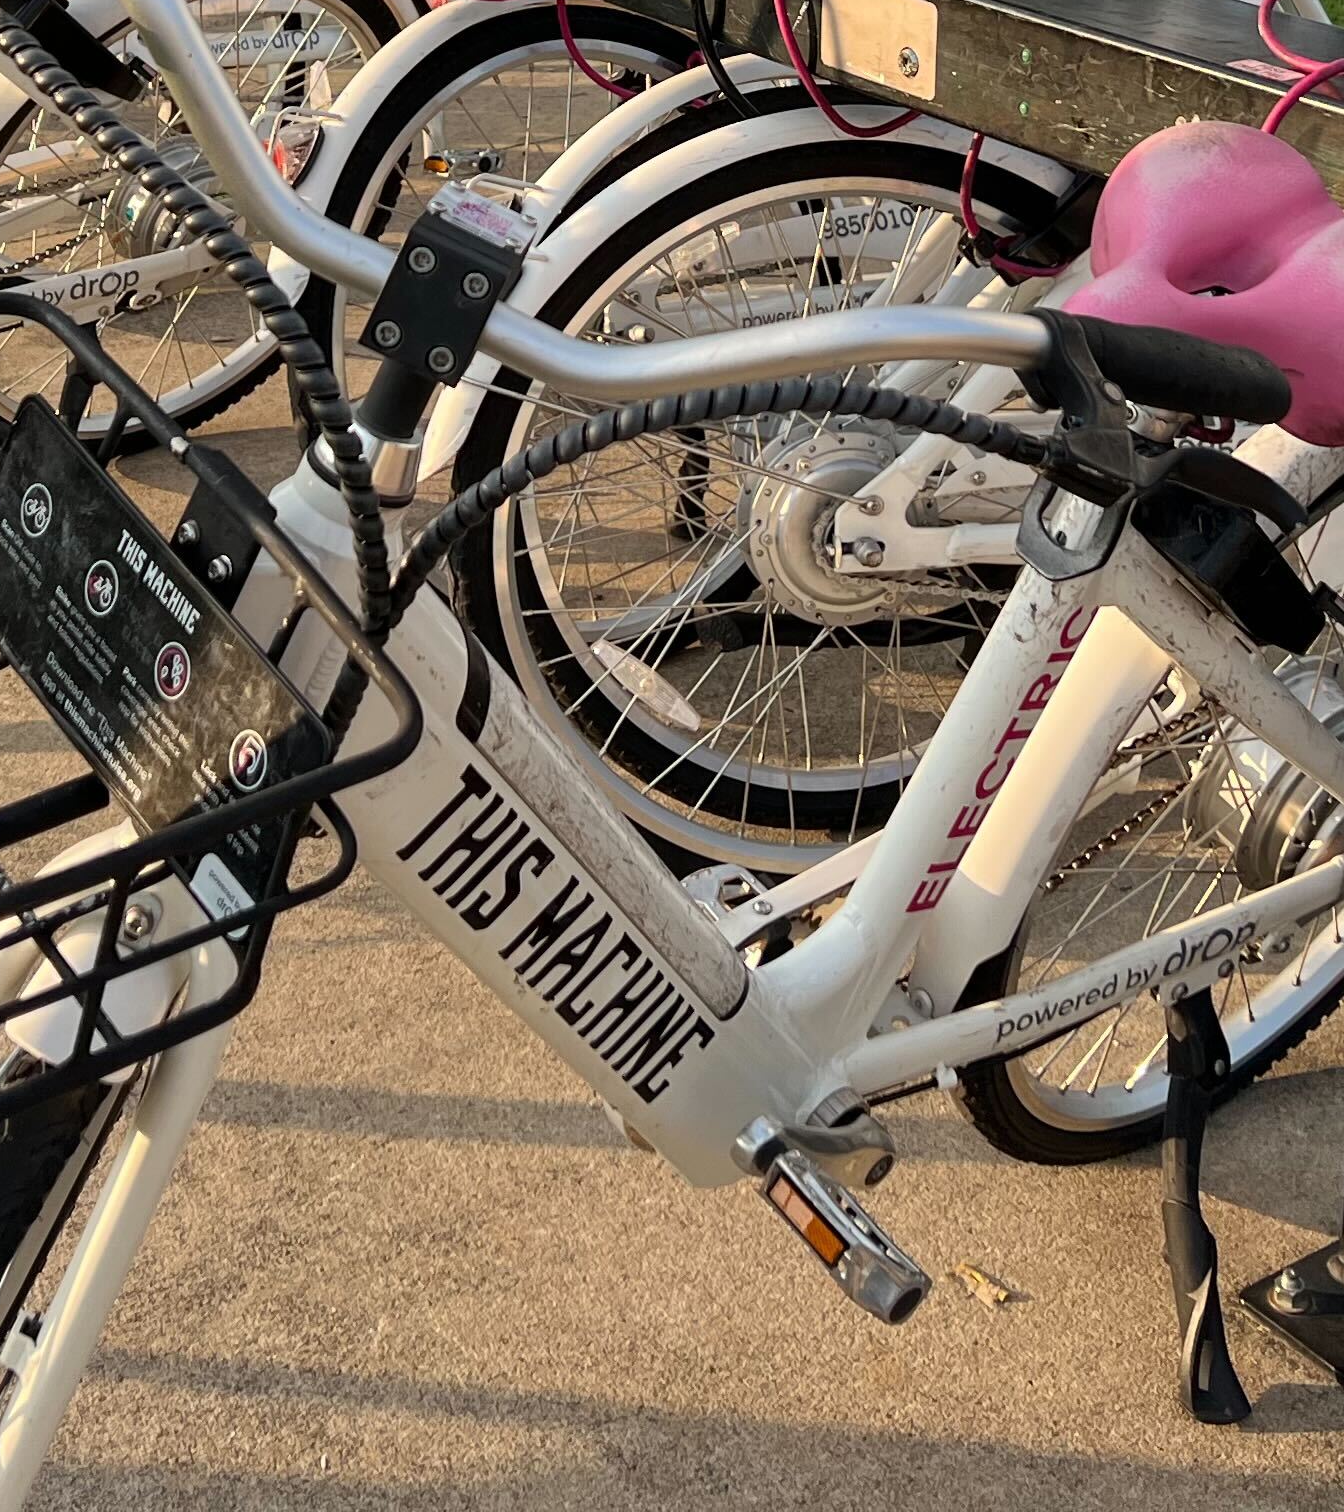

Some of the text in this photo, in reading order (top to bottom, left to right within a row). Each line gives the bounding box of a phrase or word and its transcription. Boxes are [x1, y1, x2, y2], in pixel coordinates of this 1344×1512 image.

[117, 528, 148, 574] THIS
[142, 560, 201, 635] MACHINE
[906, 605, 1100, 912] ELECTRIC
[396, 763, 716, 1104] THIS MACHINE
[996, 973, 1119, 1043] powered
[1126, 964, 1158, 990] by
